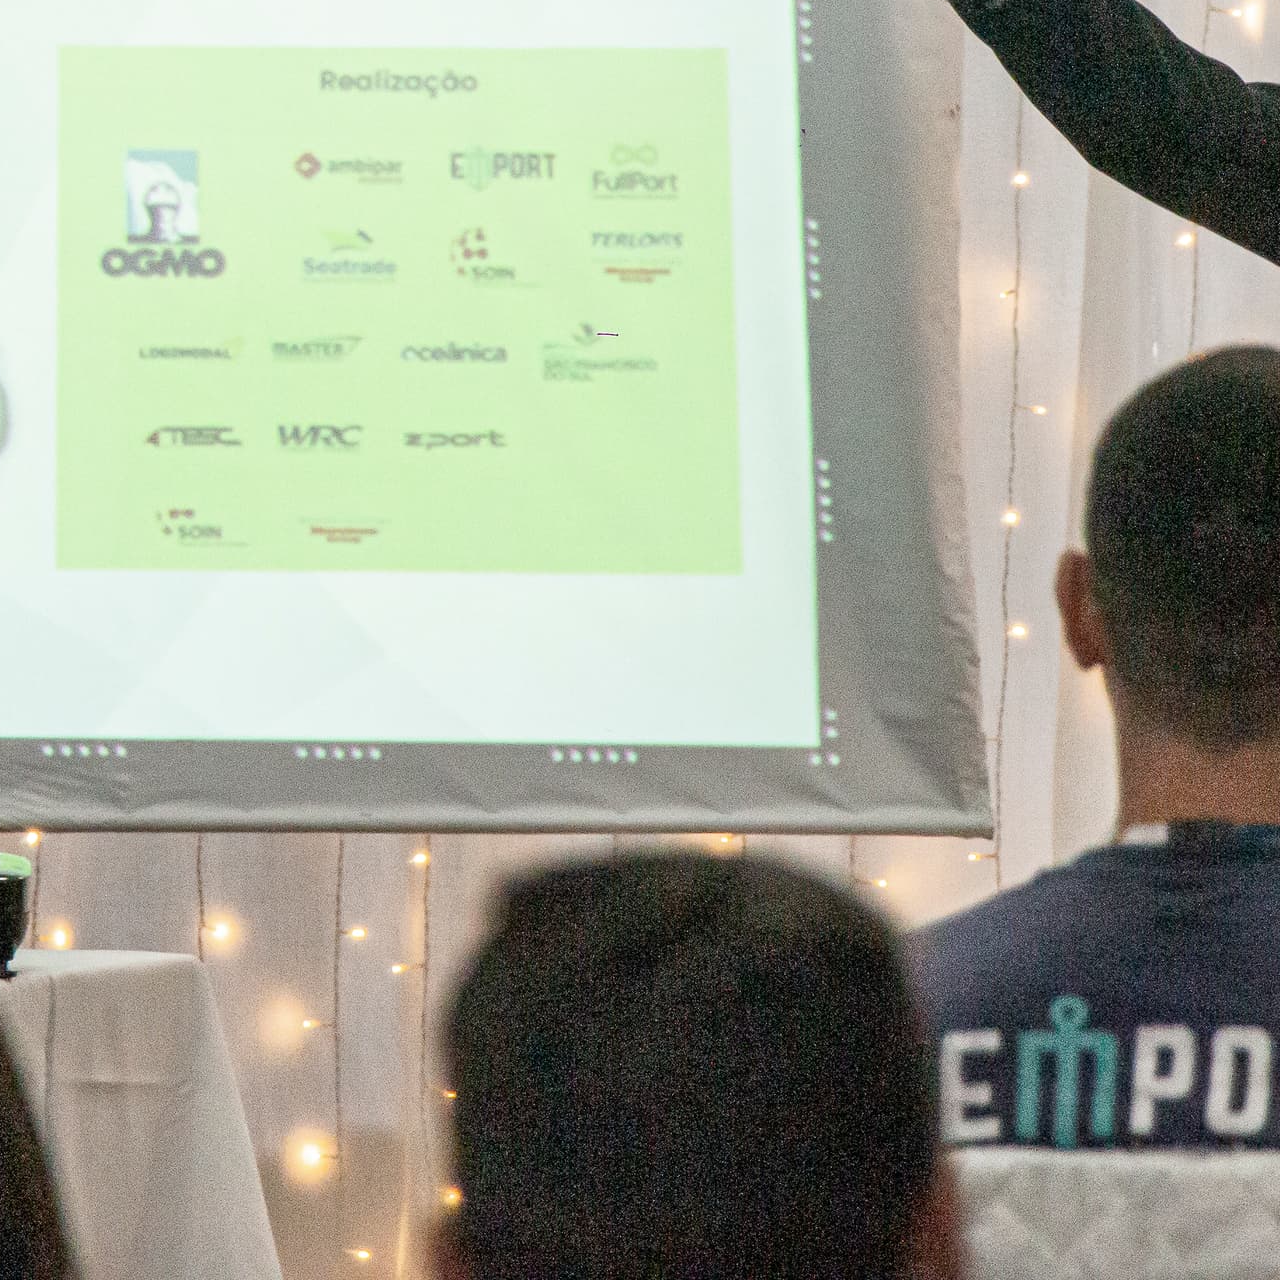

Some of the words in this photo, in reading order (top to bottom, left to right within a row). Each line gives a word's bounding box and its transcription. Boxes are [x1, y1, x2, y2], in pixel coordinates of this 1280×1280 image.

[320, 69, 478, 98] Realização
[101, 248, 226, 278] OGMO
[303, 256, 397, 276] Seatrade
[277, 425, 363, 447] WRC
